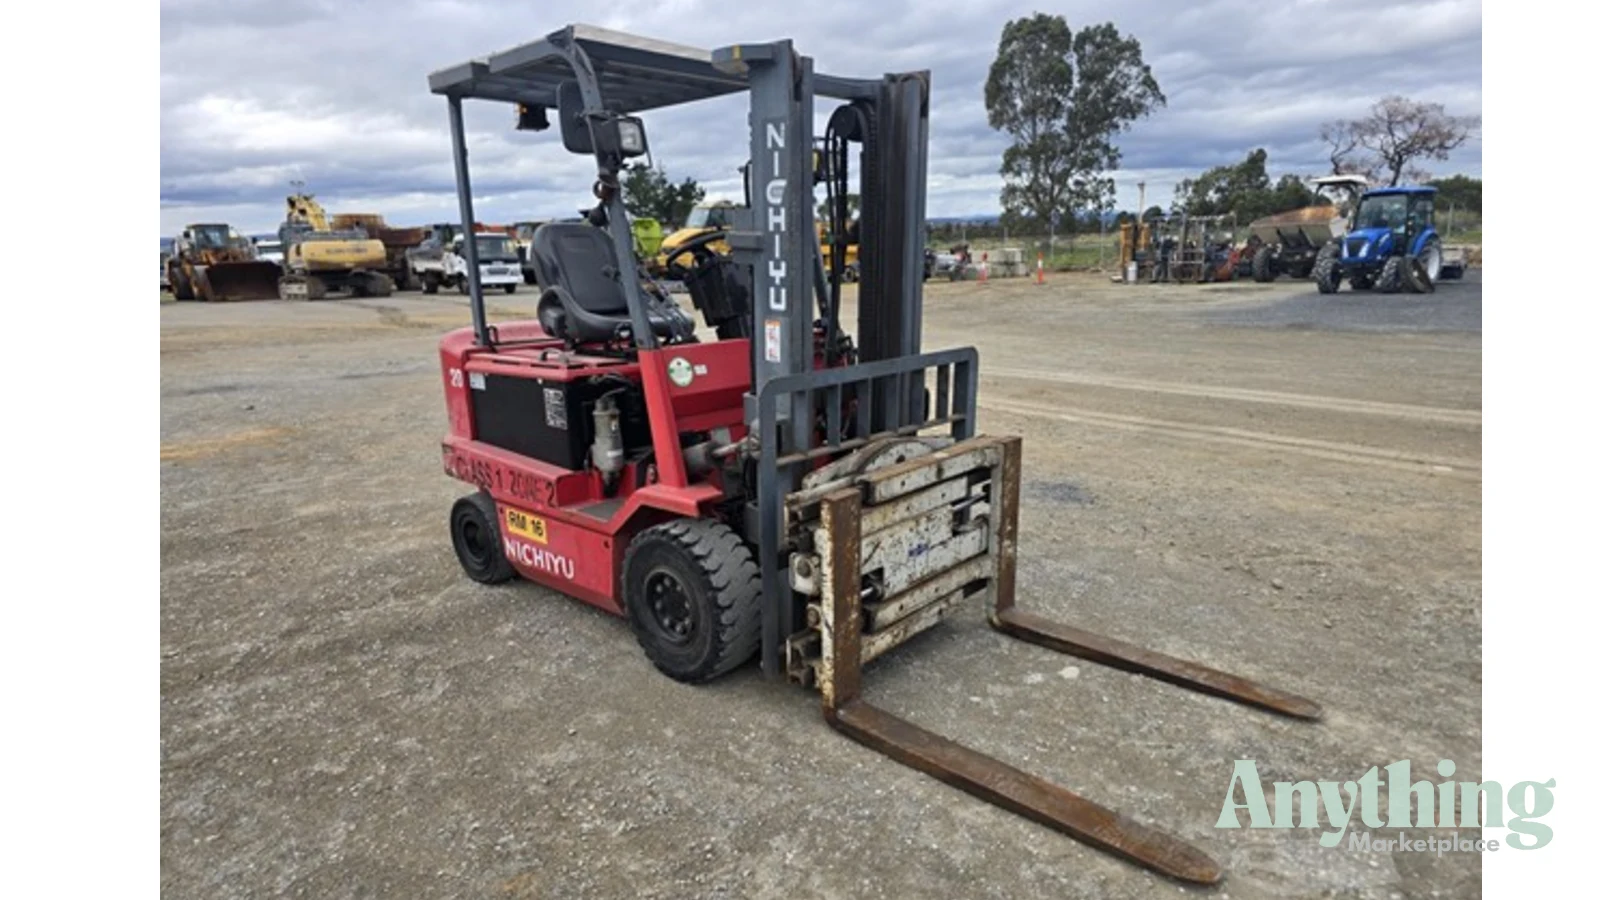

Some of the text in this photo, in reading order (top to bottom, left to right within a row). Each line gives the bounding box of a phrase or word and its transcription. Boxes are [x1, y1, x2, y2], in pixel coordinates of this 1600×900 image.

[766, 122, 787, 312] NICHIYU
[455, 455, 557, 508] CLASS 1 ZONE 2
[508, 510, 544, 537] RM 16
[502, 537, 575, 579] NICHIYU
